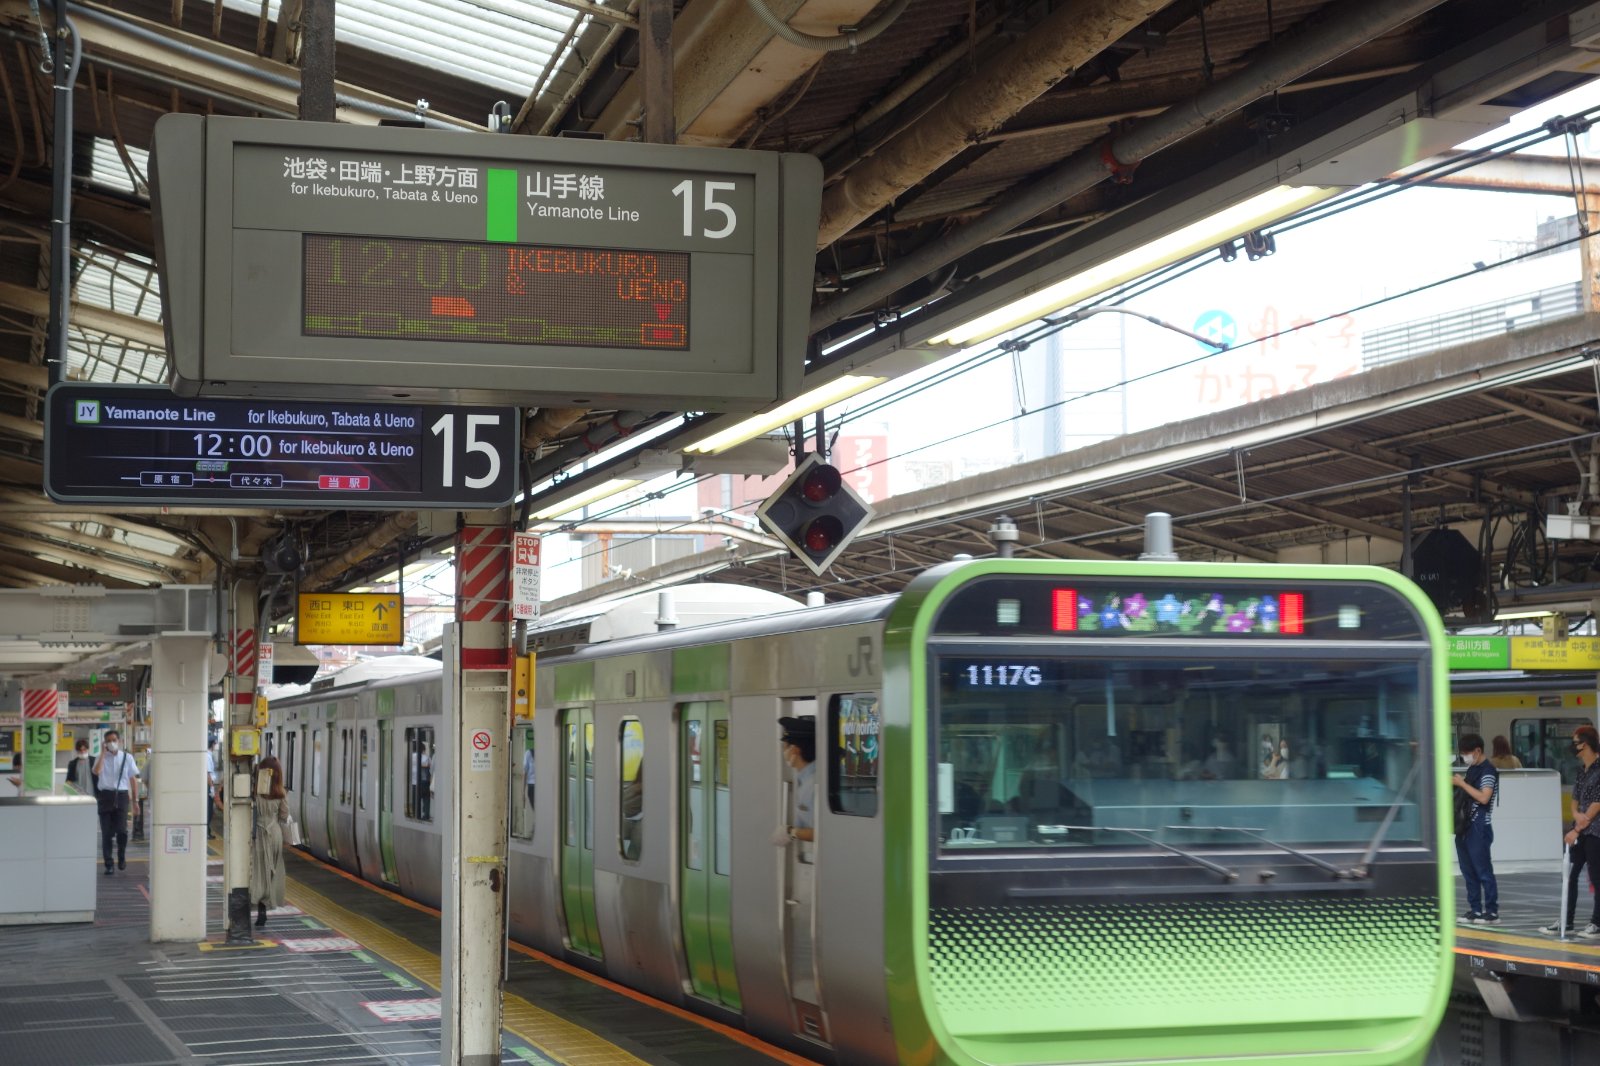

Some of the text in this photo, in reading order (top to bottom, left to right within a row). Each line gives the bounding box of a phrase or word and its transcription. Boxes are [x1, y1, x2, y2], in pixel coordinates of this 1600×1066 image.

[283, 156, 478, 188] 池袋・田端・上野方面
[291, 182, 478, 204] for Ikebukuro, Tabata & Ueno
[526, 171, 605, 201] 山手線
[527, 202, 640, 222] Yamanote Line
[671, 179, 737, 239] 15
[327, 240, 488, 290] 12:00
[507, 247, 658, 277] IKEBUKURO
[617, 278, 687, 302] UENO
[79, 405, 216, 422] JY Yamanote Line
[248, 409, 415, 428] for Ikebukuro, Tabata & Ueno
[193, 433, 272, 457] 12:00
[279, 440, 414, 457] for Ikebukuro & Ueno
[430, 413, 501, 489] 15
[153, 474, 181, 485] 原宿
[241, 475, 273, 486] 代々木
[328, 476, 361, 488] 当駅
[517, 537, 539, 547] STOP
[309, 600, 364, 611] 西口 東口
[847, 636, 873, 677] JR
[116, 673, 127, 682] 15
[966, 665, 1042, 686] 1117G
[26, 725, 52, 745] 15
